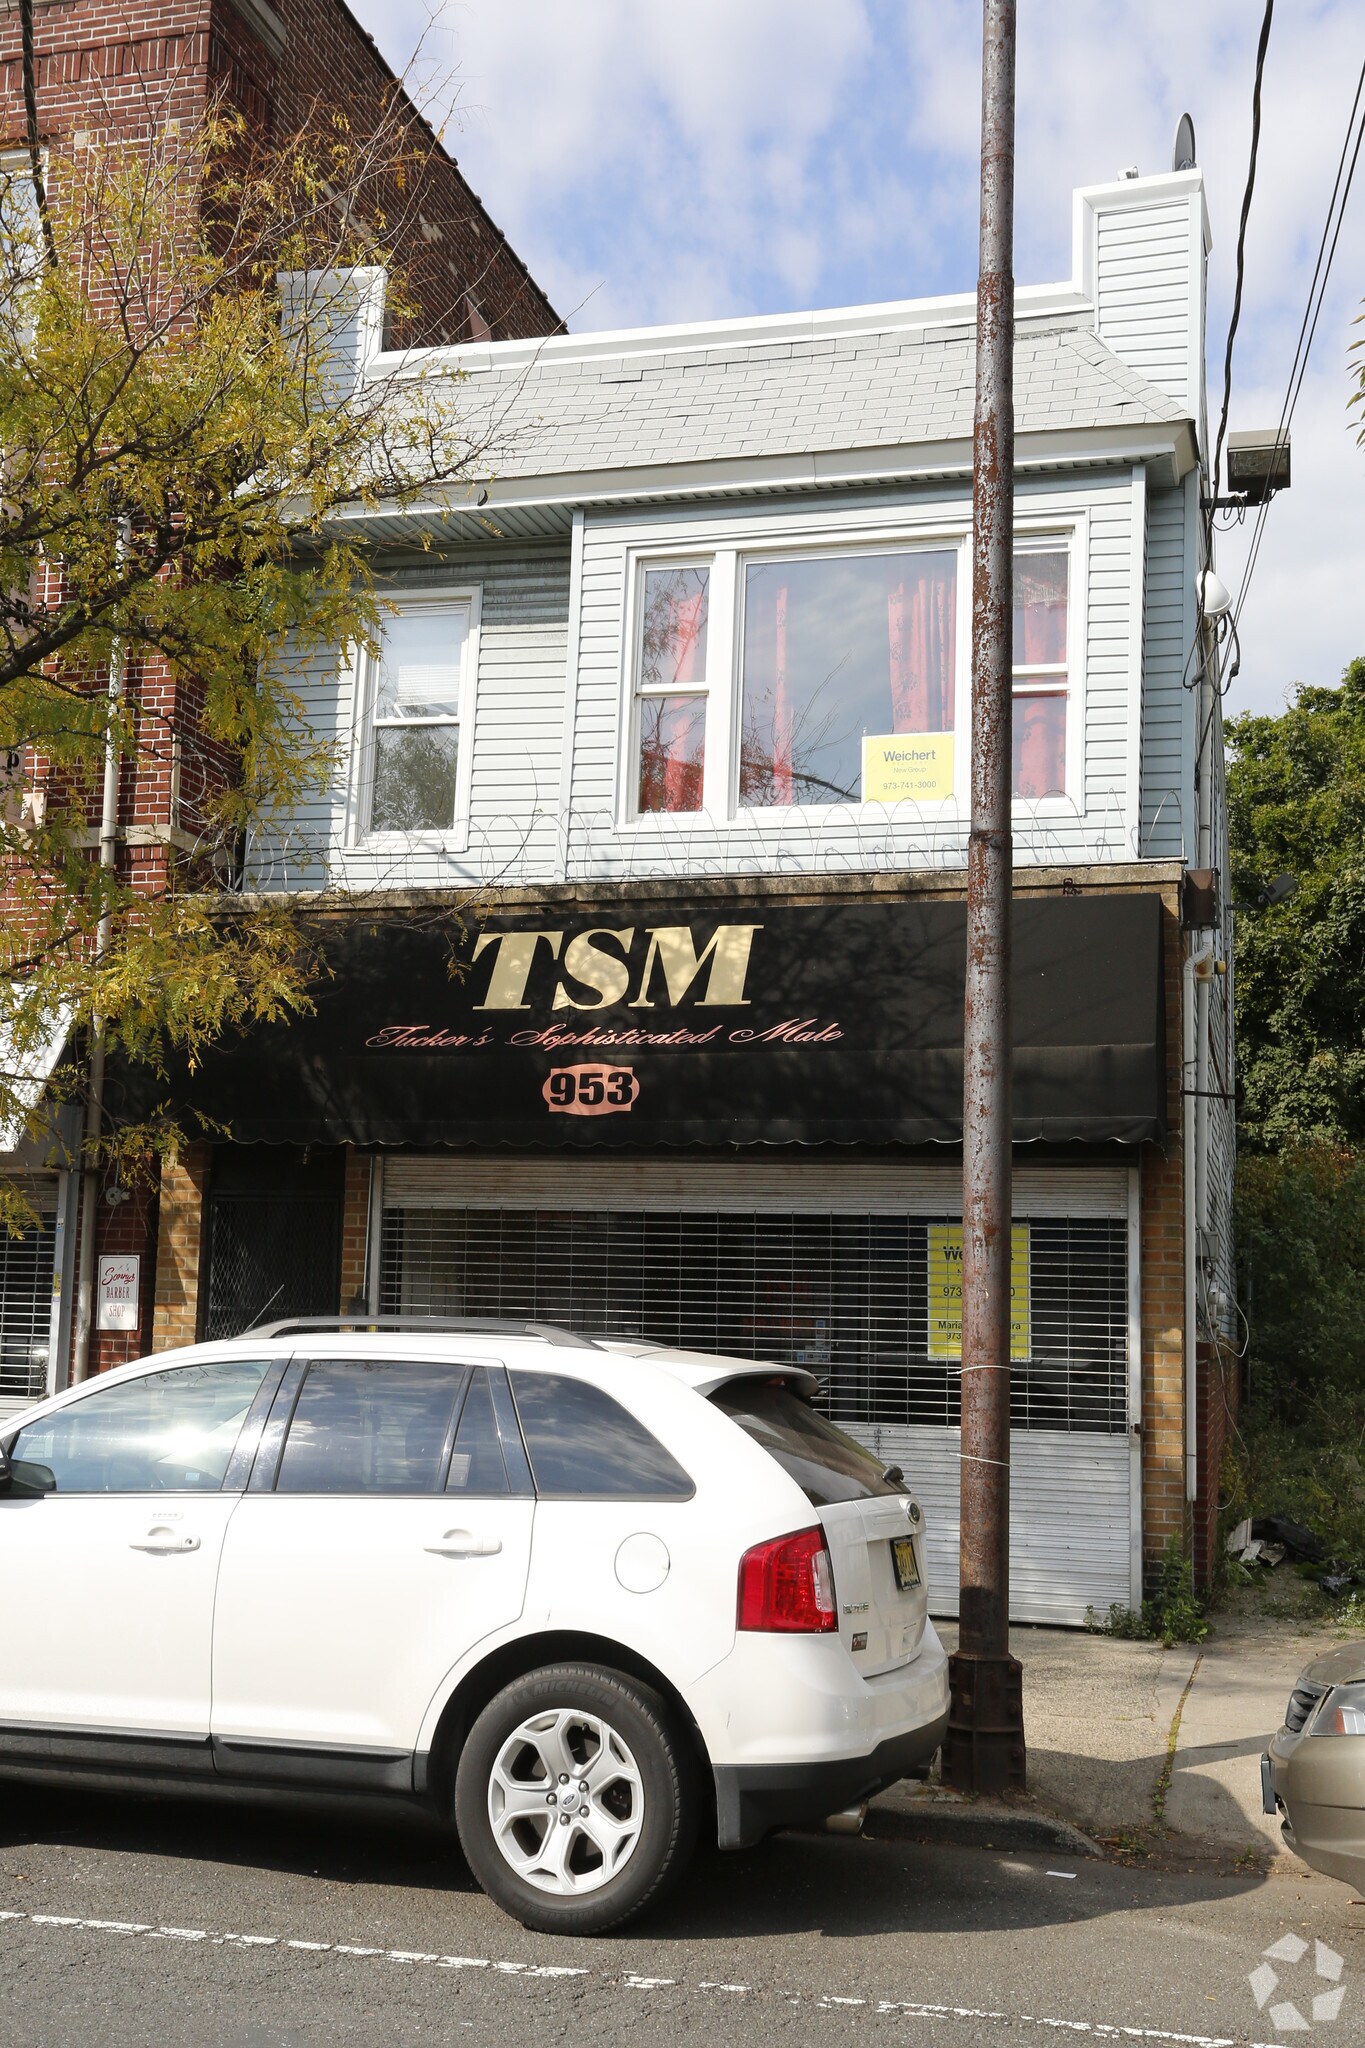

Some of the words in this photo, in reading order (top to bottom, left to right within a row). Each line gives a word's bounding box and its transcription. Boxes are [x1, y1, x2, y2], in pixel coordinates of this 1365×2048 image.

[884, 750, 936, 762] Weichert
[883, 781, 936, 790] 973-741-3000
[471, 924, 765, 1012] TSM
[365, 1024, 495, 1049] Tucker's
[504, 1022, 724, 1052] Sophisticated
[728, 1018, 845, 1044] Male
[549, 1071, 634, 1106] 953
[106, 1286, 130, 1299] BARBER
[109, 1304, 125, 1317] SHOP
[532, 1680, 617, 1706] MICHELIN
